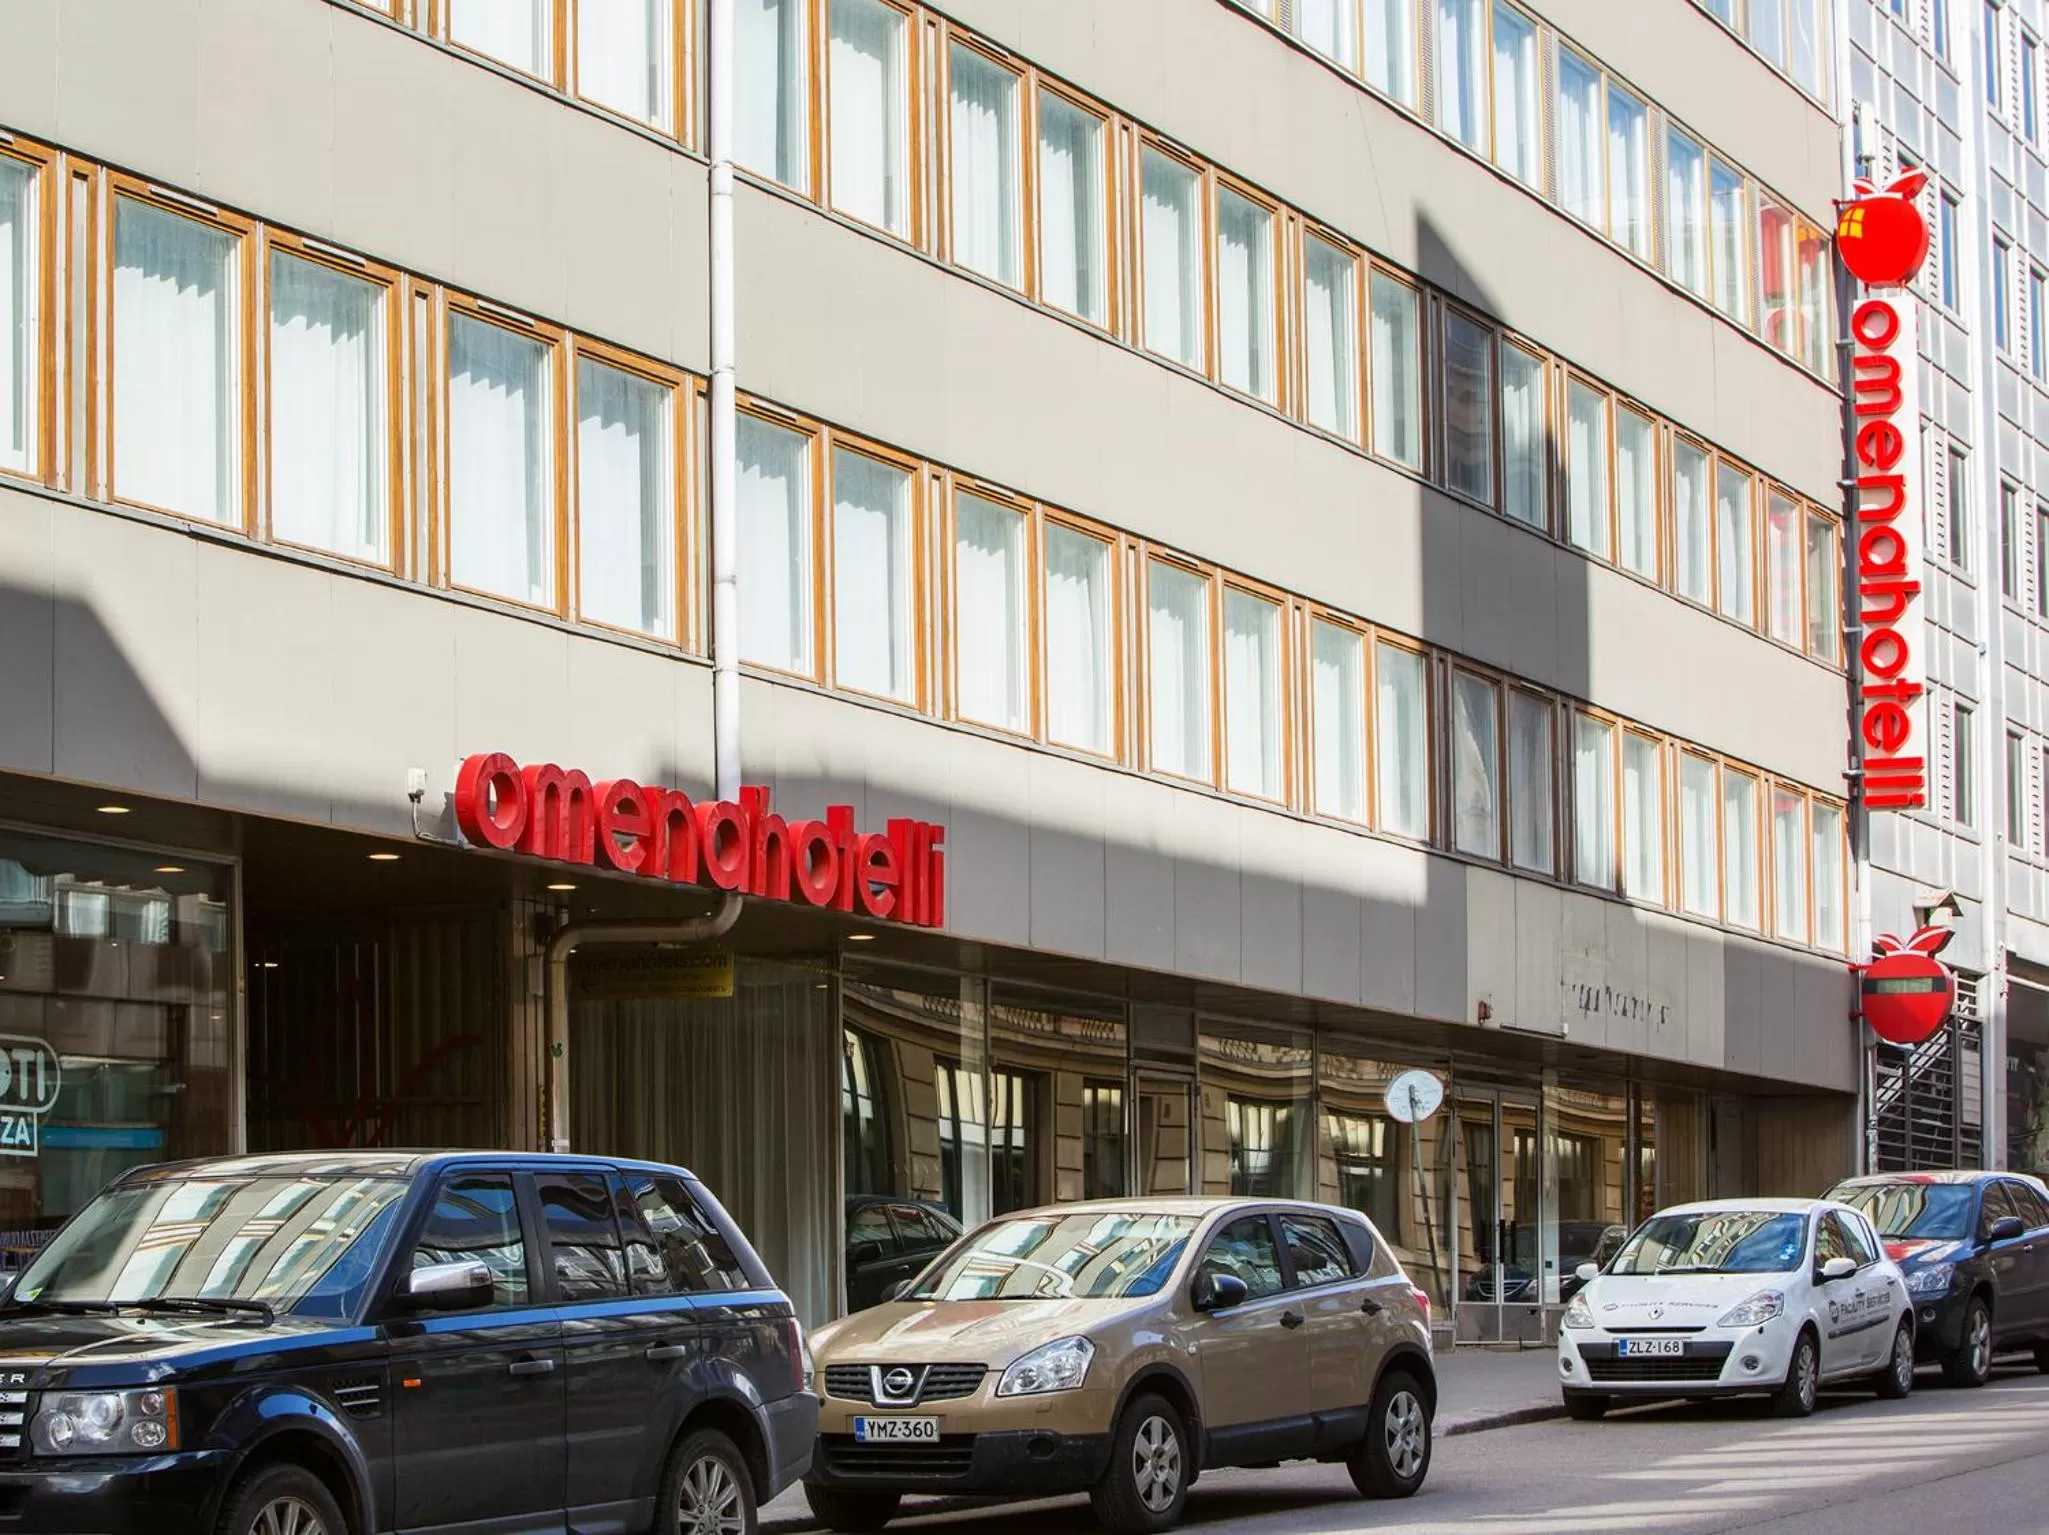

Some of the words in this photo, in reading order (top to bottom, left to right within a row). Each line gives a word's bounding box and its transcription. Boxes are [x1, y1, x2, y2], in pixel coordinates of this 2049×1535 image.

[1852, 299, 1924, 808] omenahotelli
[455, 752, 945, 928] omenahotelli
[1629, 1341, 1680, 1354] ZLZ-168
[868, 1421, 934, 1438] YMZ-360
